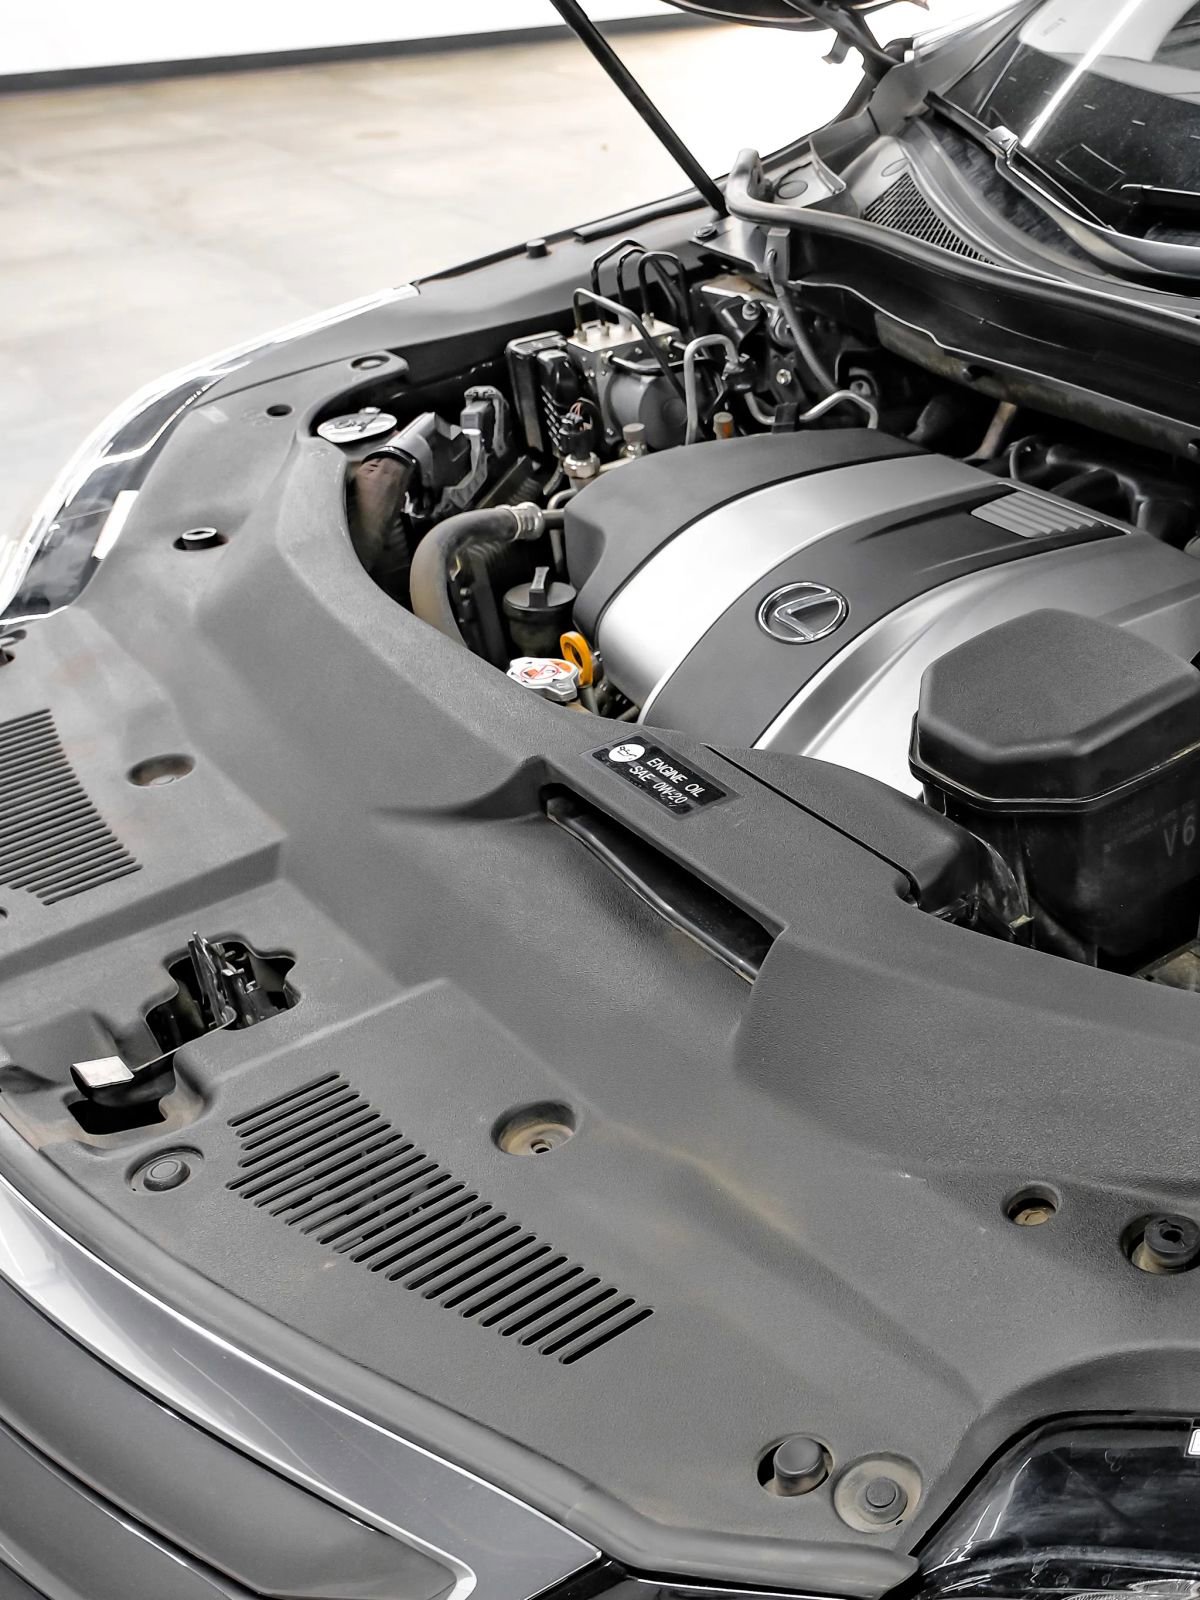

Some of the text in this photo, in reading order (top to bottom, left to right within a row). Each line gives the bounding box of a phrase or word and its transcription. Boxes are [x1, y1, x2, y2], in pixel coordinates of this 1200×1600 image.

[629, 765, 689, 804] SAE 0W-20
[646, 757, 706, 798] ENGINE OIL
